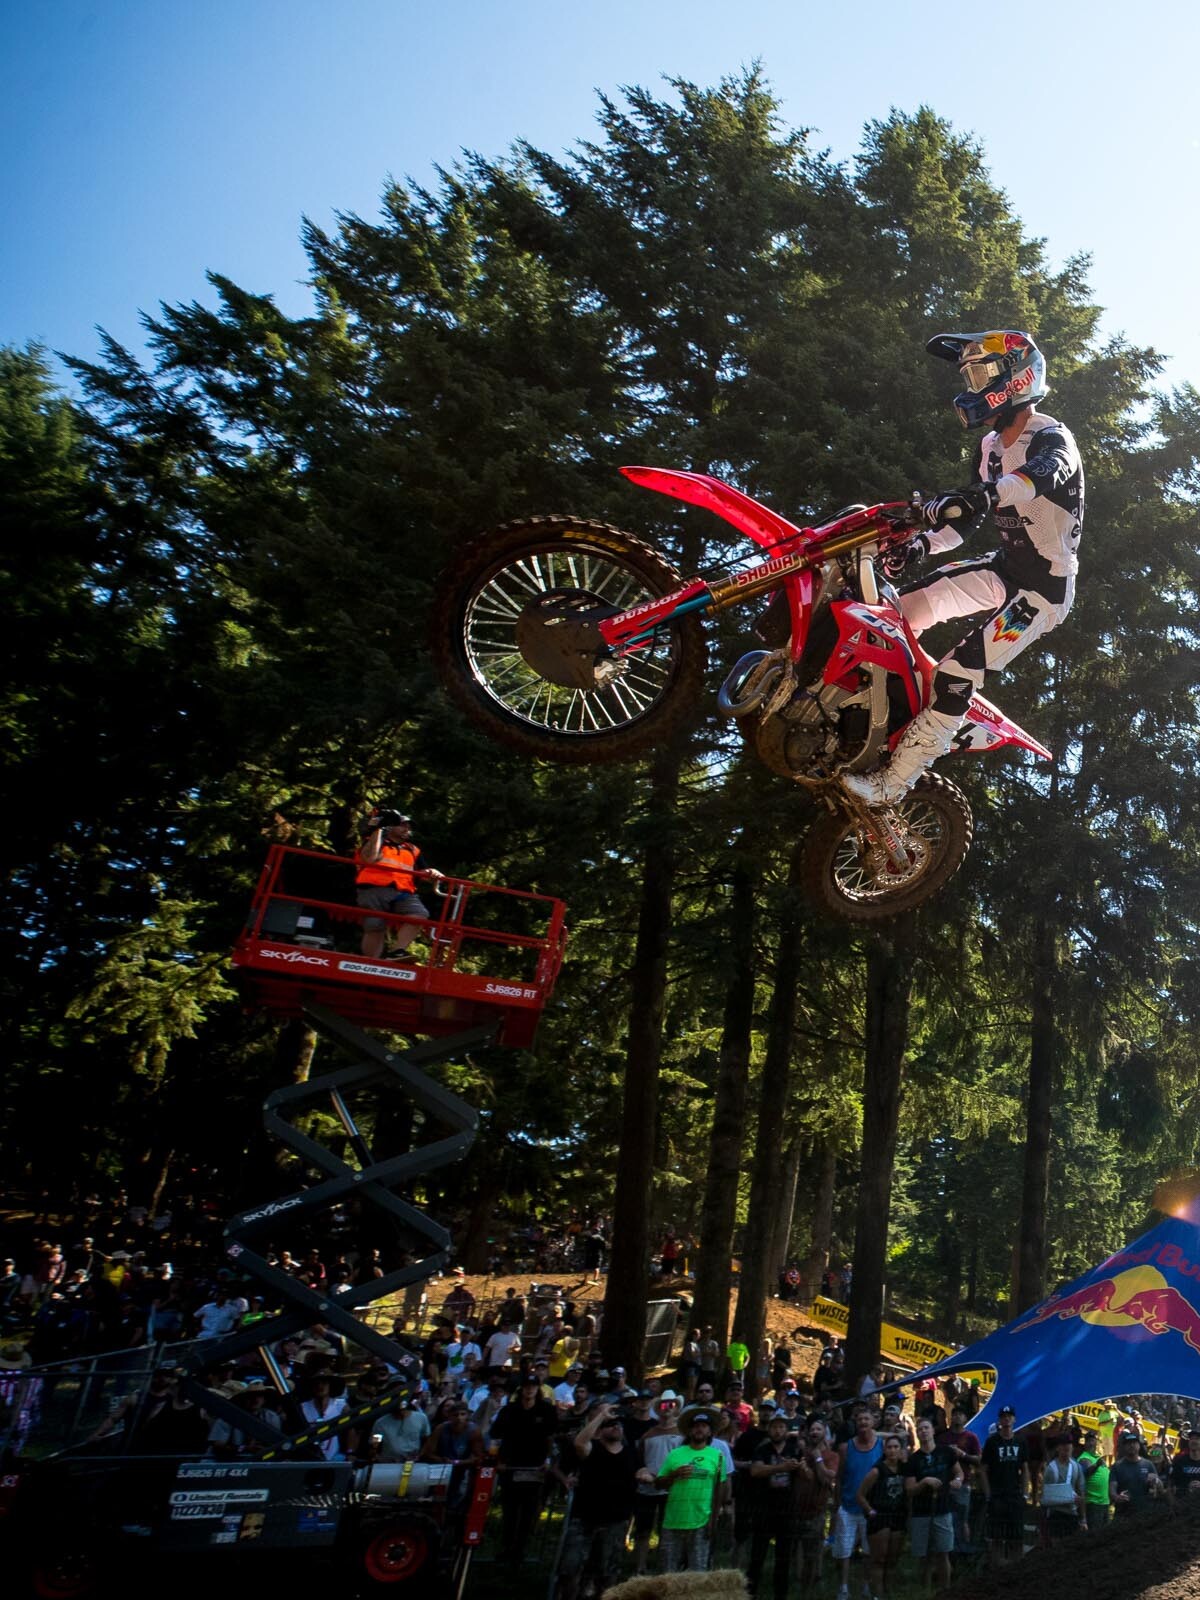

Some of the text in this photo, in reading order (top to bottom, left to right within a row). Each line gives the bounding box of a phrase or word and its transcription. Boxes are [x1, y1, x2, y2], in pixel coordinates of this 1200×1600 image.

[985, 367, 1036, 409] Red Bull
[737, 555, 794, 587] SHOWA
[612, 591, 683, 625] DUNLOP
[967, 698, 996, 722] ONDA
[259, 949, 330, 967] SKYJACK
[485, 983, 538, 999] SJ6826 RT
[242, 1197, 303, 1223] SKYJACK
[894, 1337, 938, 1358] TWISTED
[998, 1446, 1020, 1457] FLY
